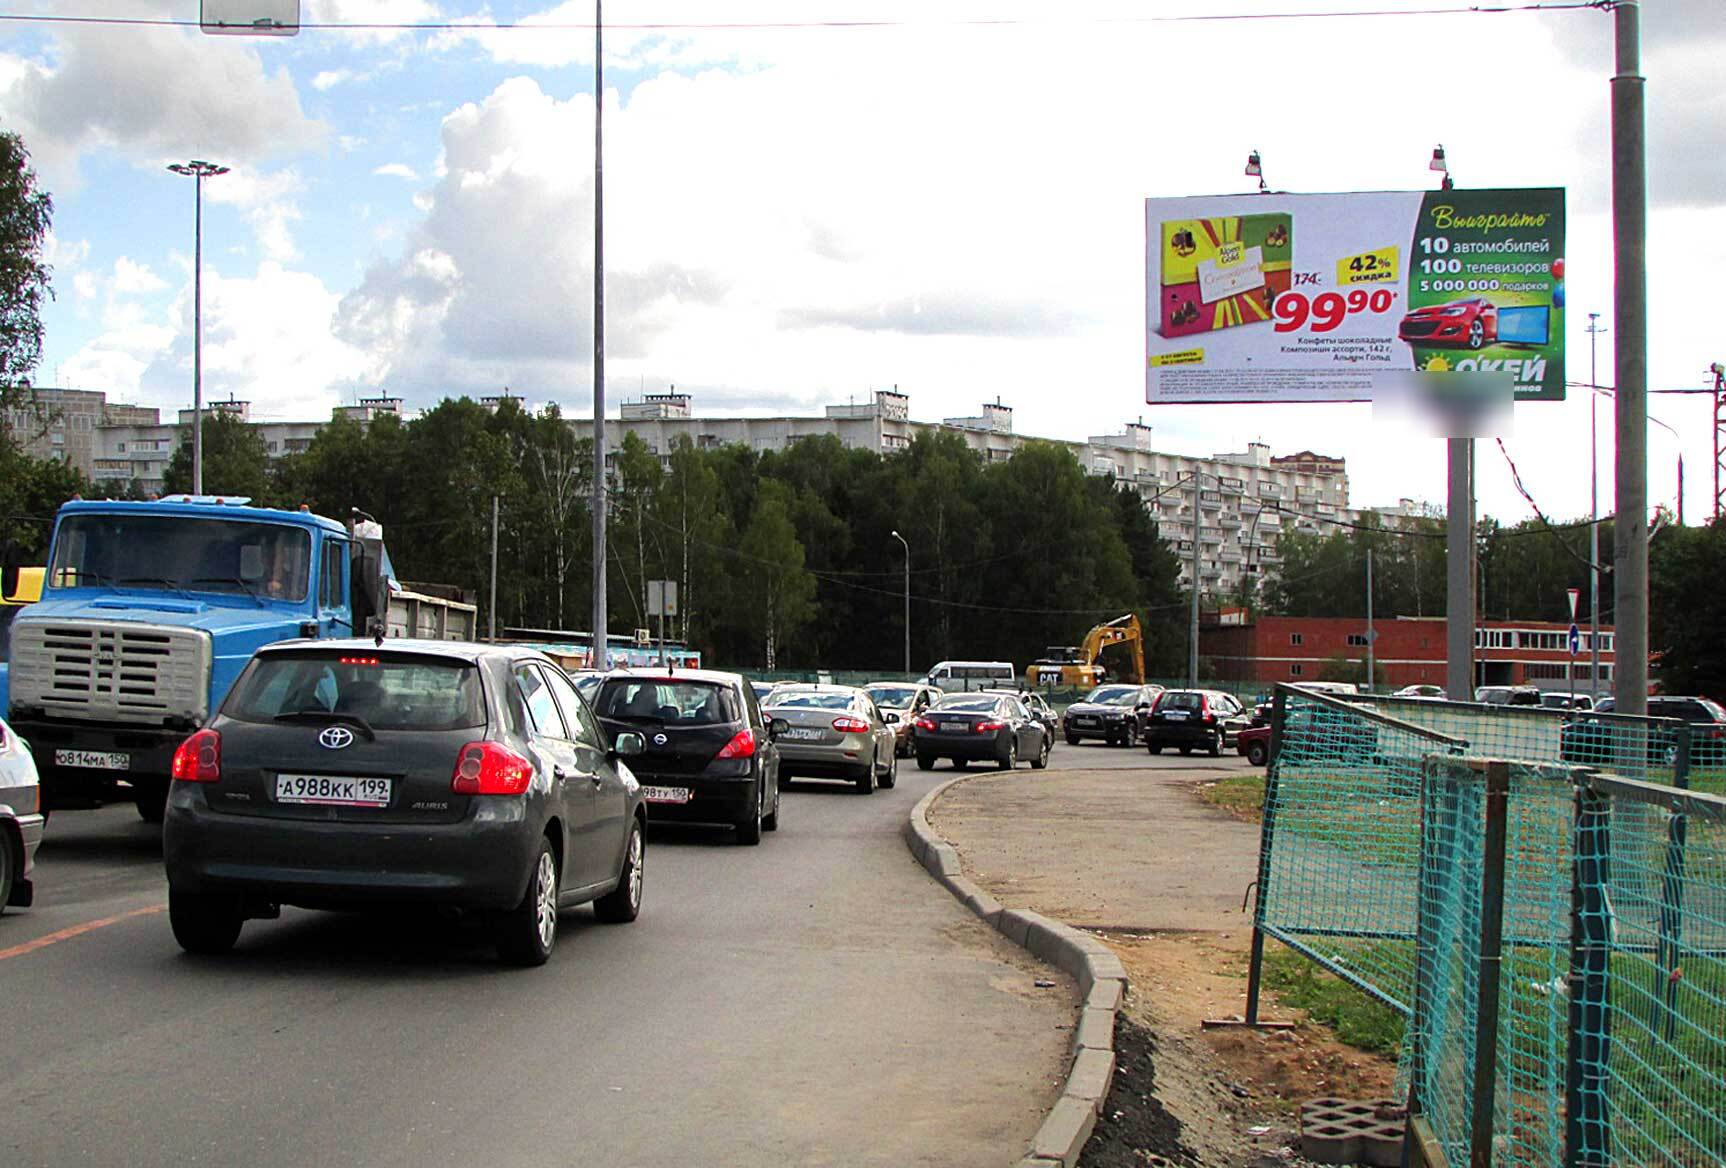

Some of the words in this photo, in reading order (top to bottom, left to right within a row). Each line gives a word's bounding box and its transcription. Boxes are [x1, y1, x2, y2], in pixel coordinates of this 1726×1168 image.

[1431, 205, 1547, 234] Выиграйте
[1420, 237, 1449, 254] 10
[1453, 239, 1549, 253] автомобилей
[1350, 255, 1391, 272] 42%
[1420, 259, 1461, 274] 100
[1466, 263, 1549, 276] телевизоров
[1350, 272, 1392, 282] скидка
[1420, 280, 1429, 291] 5
[1433, 280, 1465, 291] 000
[1468, 280, 1499, 290] 000
[1503, 282, 1549, 292] подарков
[1040, 673, 1059, 686] CAT
